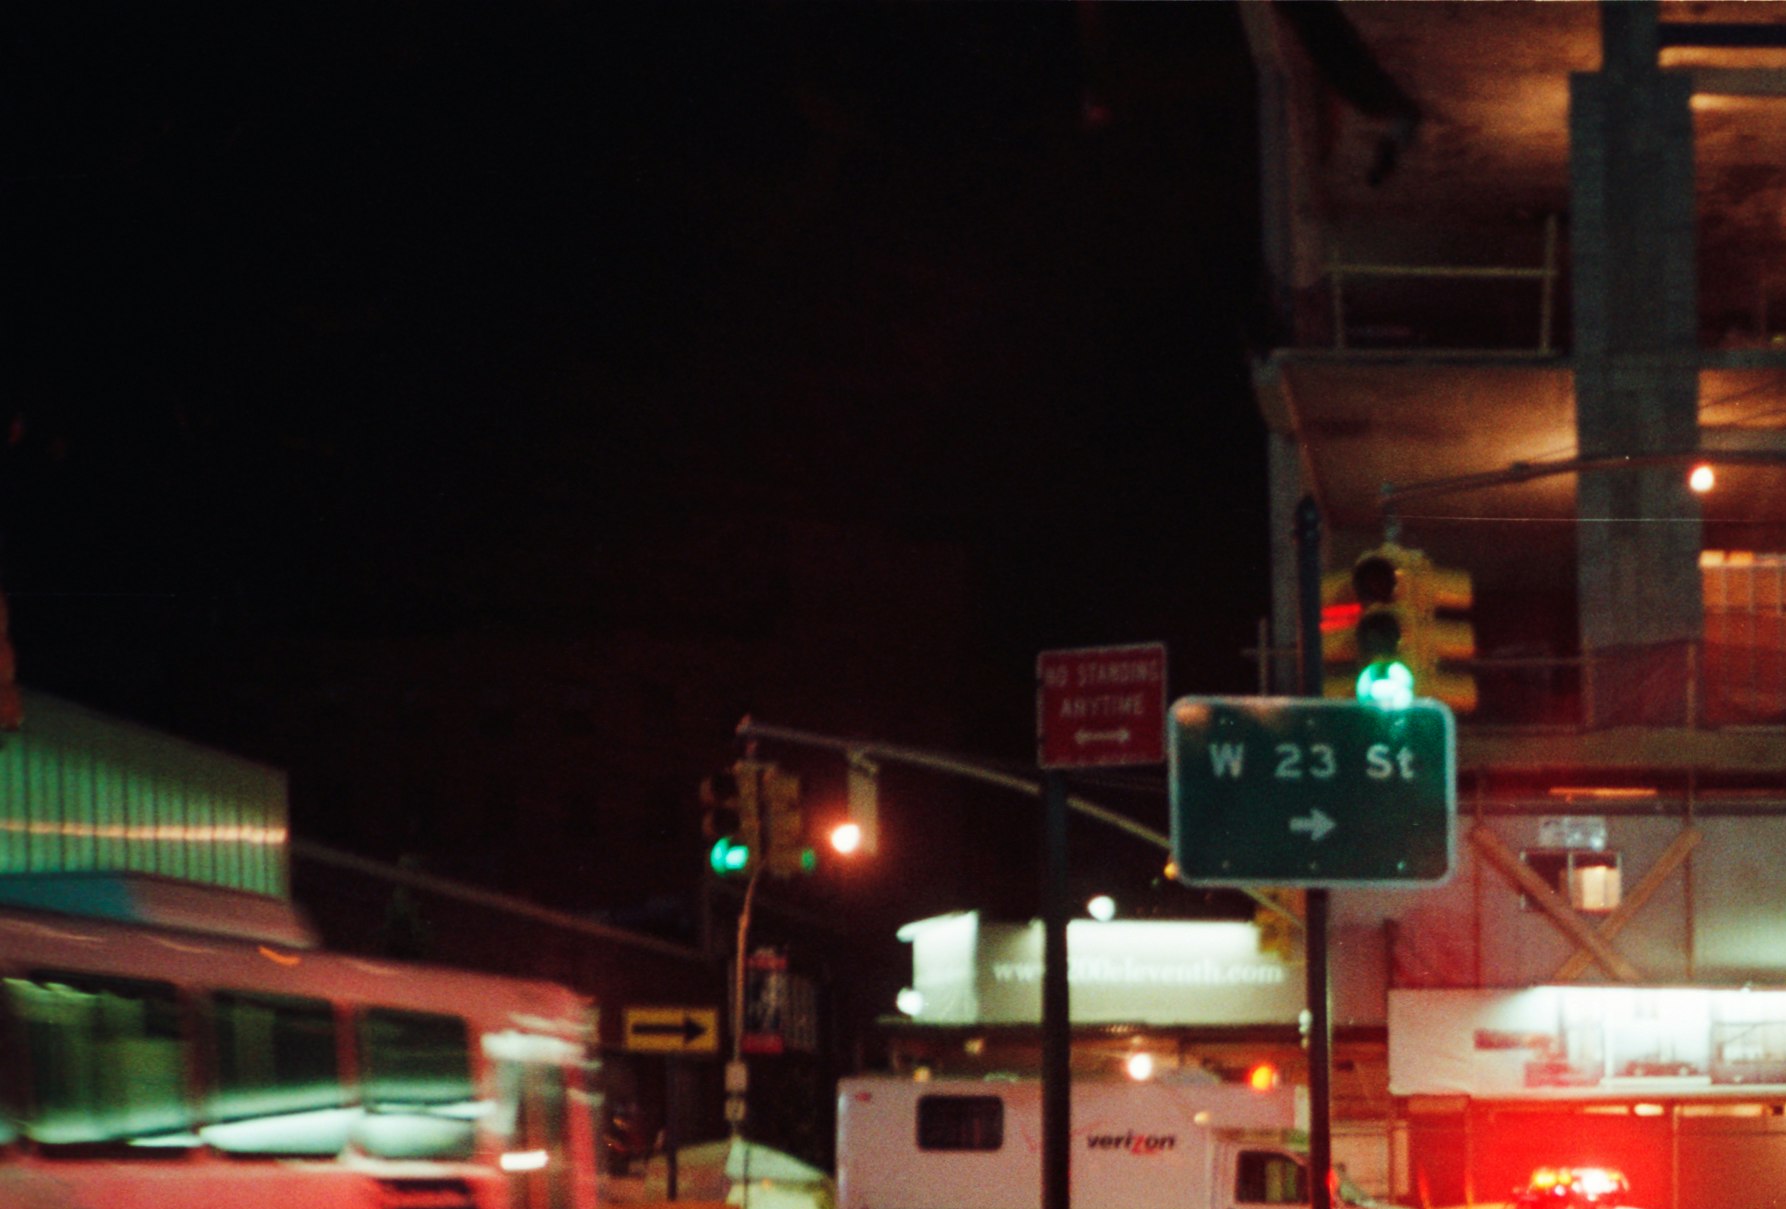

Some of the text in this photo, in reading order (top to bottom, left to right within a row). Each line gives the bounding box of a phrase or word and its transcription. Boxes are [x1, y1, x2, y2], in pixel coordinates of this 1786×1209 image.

[1044, 660, 1159, 688] NO STANDING
[1060, 692, 1145, 717] ANYTIME
[1208, 742, 1416, 780] W 23 St
[1086, 1129, 1176, 1156] verizon
